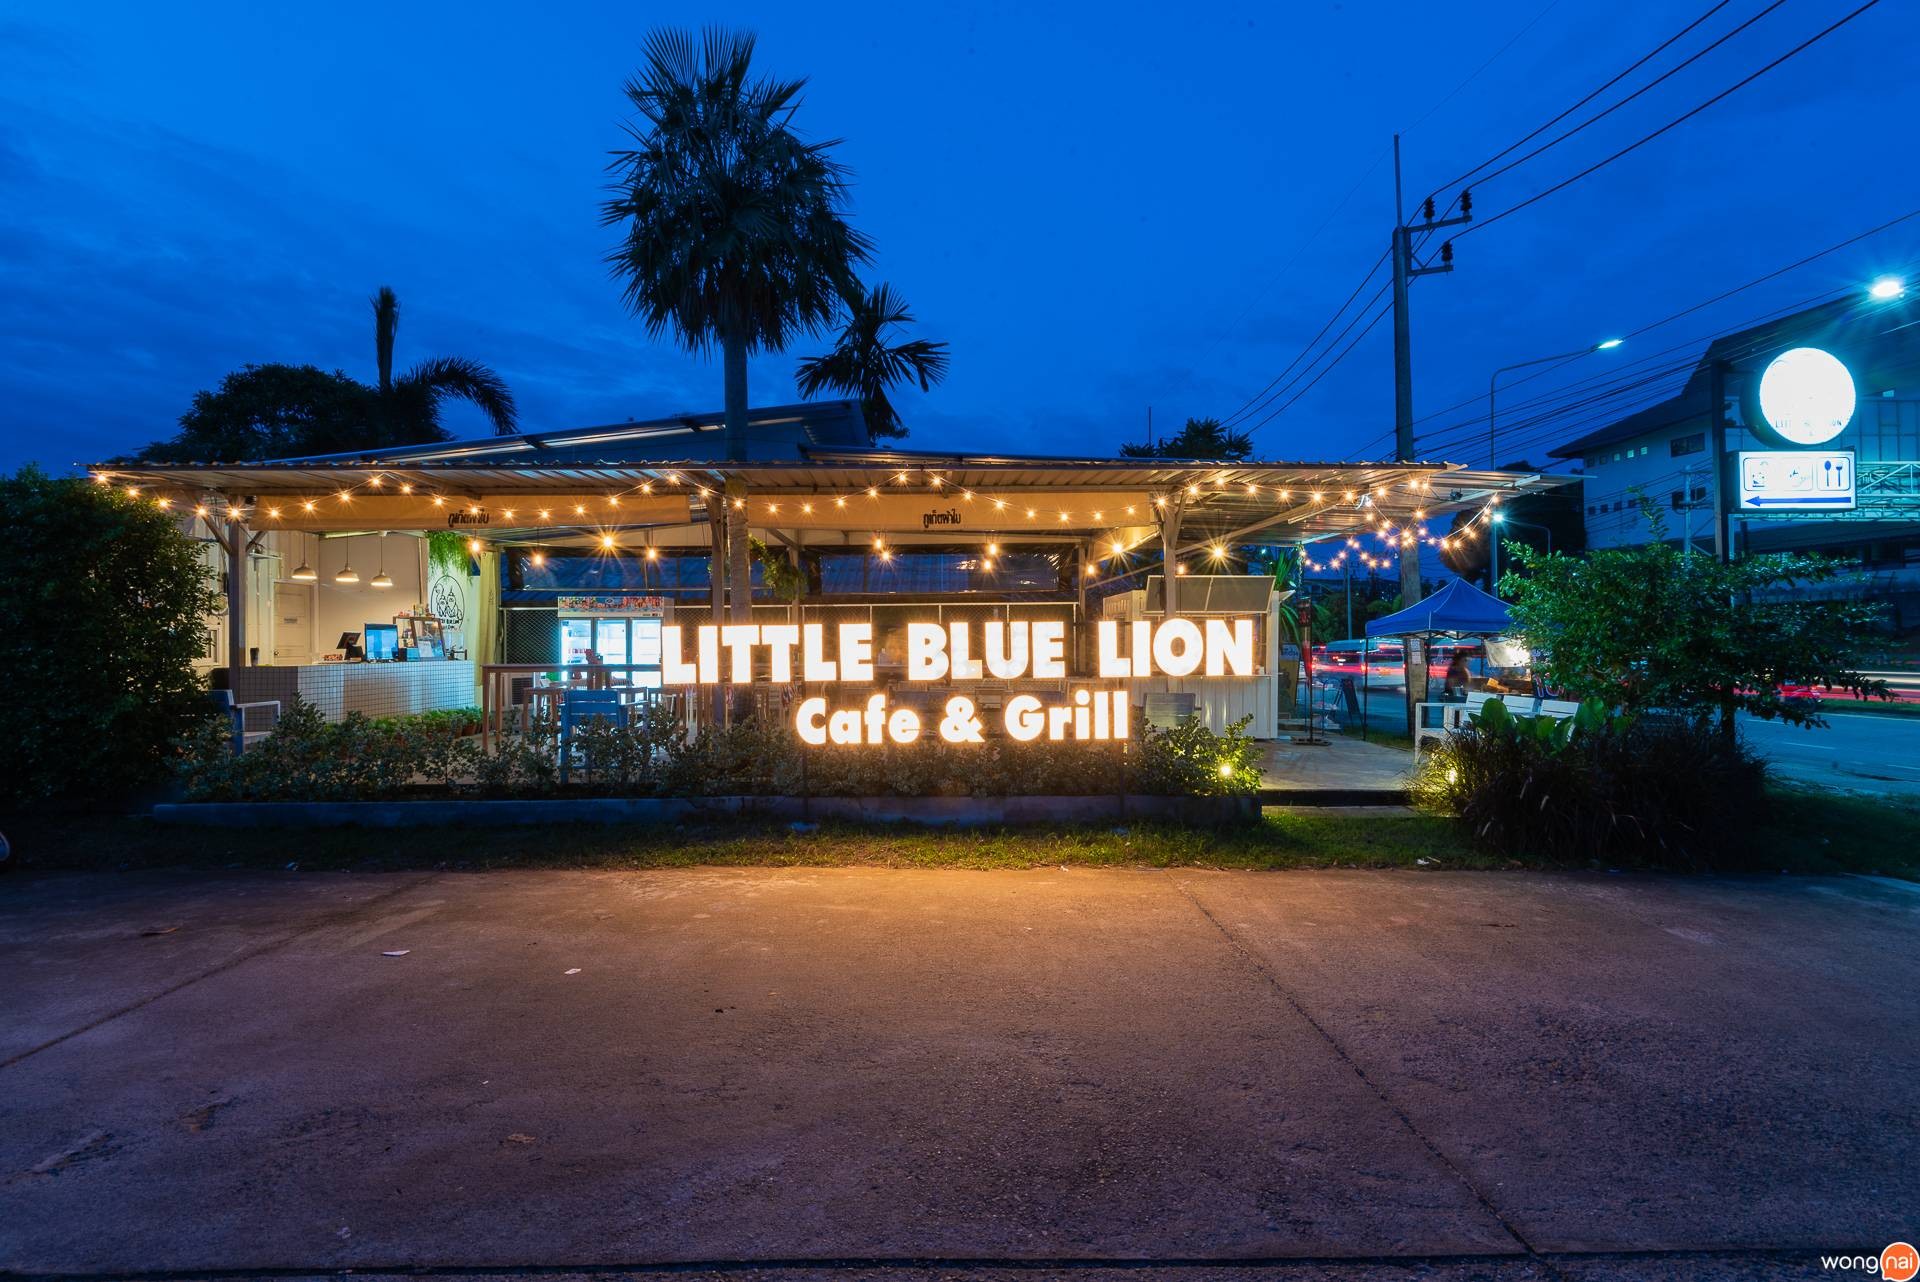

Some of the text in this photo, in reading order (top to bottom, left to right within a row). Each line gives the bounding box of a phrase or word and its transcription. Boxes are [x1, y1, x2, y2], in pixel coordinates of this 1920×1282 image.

[661, 618, 1253, 684] LITTLE BLUE LION
[796, 689, 1129, 745] Cafe & Grill
